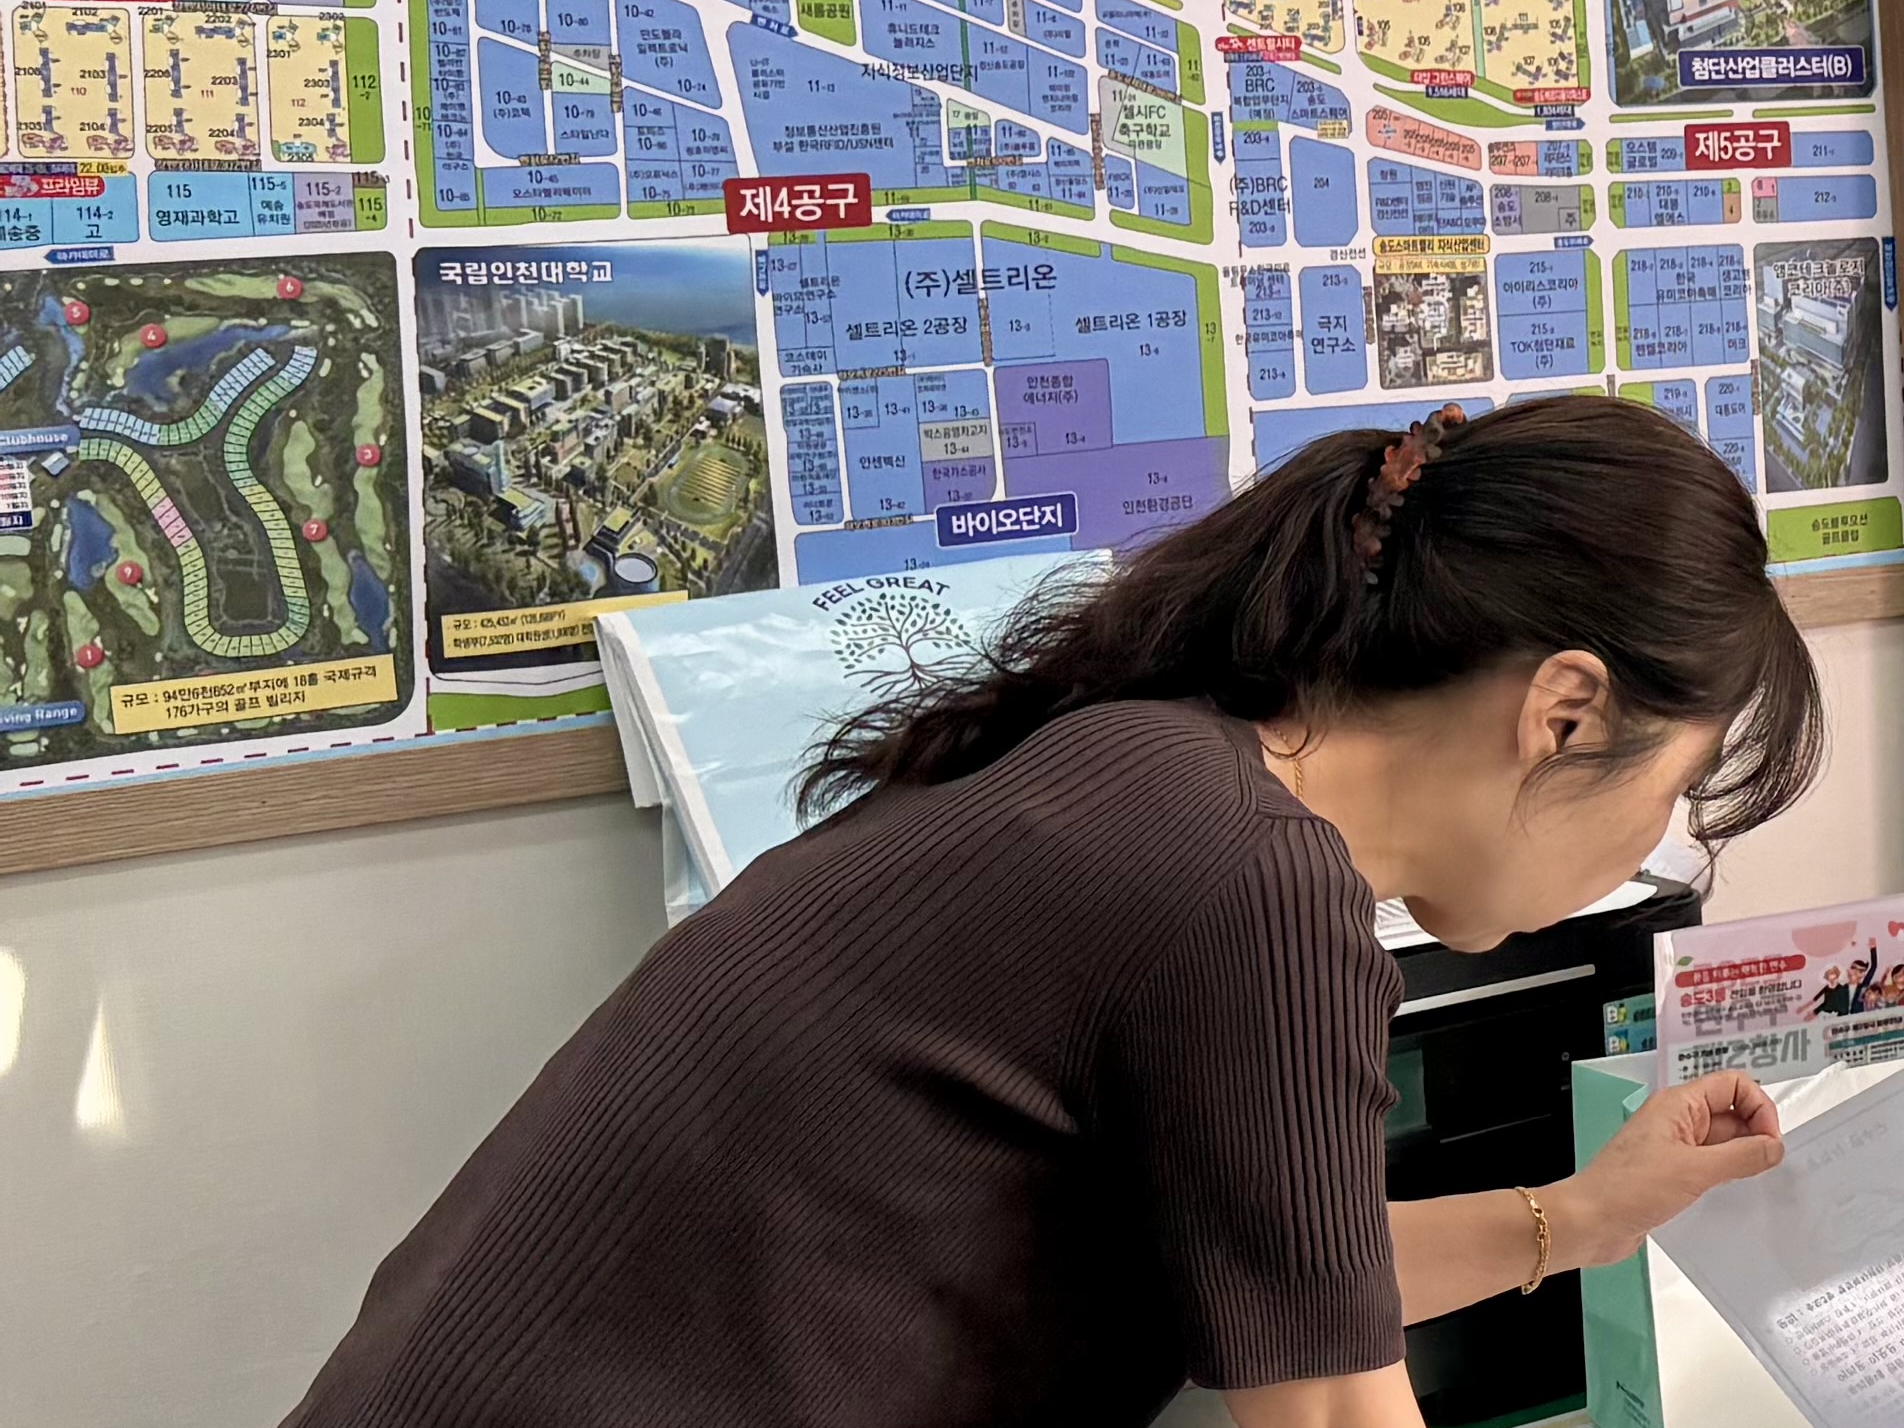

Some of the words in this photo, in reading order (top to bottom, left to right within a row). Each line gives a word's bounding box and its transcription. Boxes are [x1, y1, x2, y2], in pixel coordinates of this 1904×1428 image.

[861, 62, 979, 83] 지식정보산업단지
[1692, 55, 1852, 80] 첨단산업클러스터(B)
[352, 74, 377, 90] 112
[1244, 78, 1276, 94] BRC
[1694, 129, 1783, 164] 제5공구
[40, 176, 100, 195] 프라임뷰
[167, 184, 192, 200] 115
[739, 184, 859, 222] 제4공구
[155, 207, 241, 228] 영재과학고
[85, 224, 101, 240] 고
[438, 260, 613, 286] 국립인천대학교
[904, 264, 1058, 298] (주)셀트리온
[845, 317, 918, 340] 셀트리온
[923, 314, 968, 336] 2공장
[1075, 314, 1139, 333] 셀트리온
[1145, 308, 1187, 330] 1공장
[1317, 315, 1348, 333] 극지
[1312, 334, 1357, 354] 연구소
[951, 503, 1063, 535] 바이오단지
[812, 580, 864, 612] FEEL
[866, 576, 950, 596] GREAT
[122, 694, 150, 707] 규모
[323, 665, 377, 683] 국제규격
[233, 697, 261, 711] 골프
